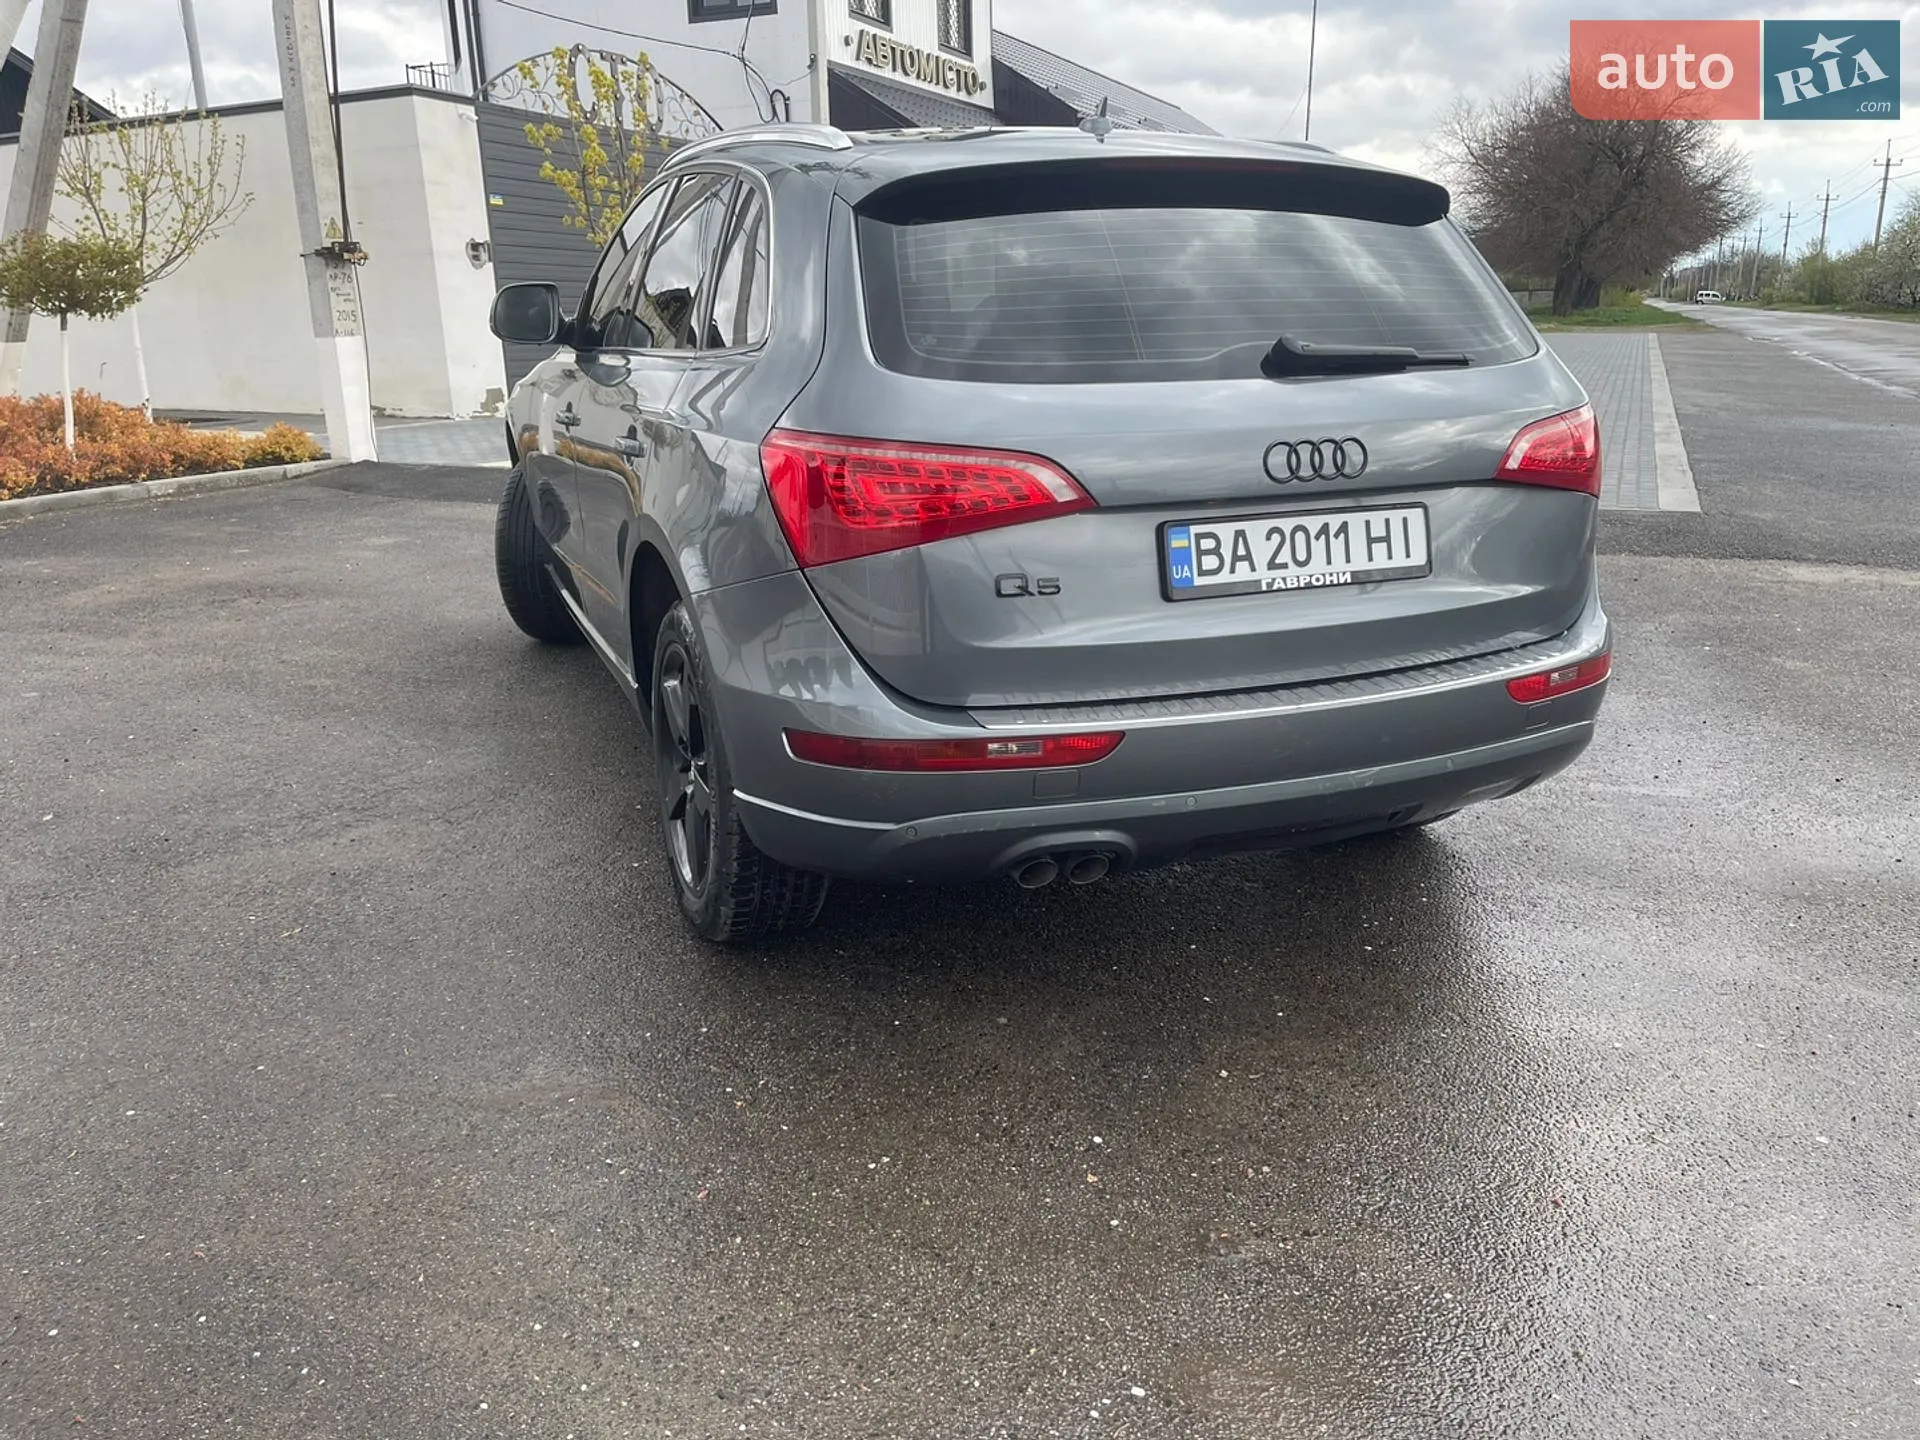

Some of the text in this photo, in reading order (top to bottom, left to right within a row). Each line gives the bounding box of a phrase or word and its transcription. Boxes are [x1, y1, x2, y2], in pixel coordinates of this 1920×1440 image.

[855, 29, 980, 96] АВТОМІСТО
[336, 310, 358, 323] 2015
[1194, 516, 1411, 577] BA 2011 HI
[1173, 565, 1192, 579] UA
[1261, 571, 1352, 591] ГАВРОНИ
[995, 573, 1061, 598] Q5
